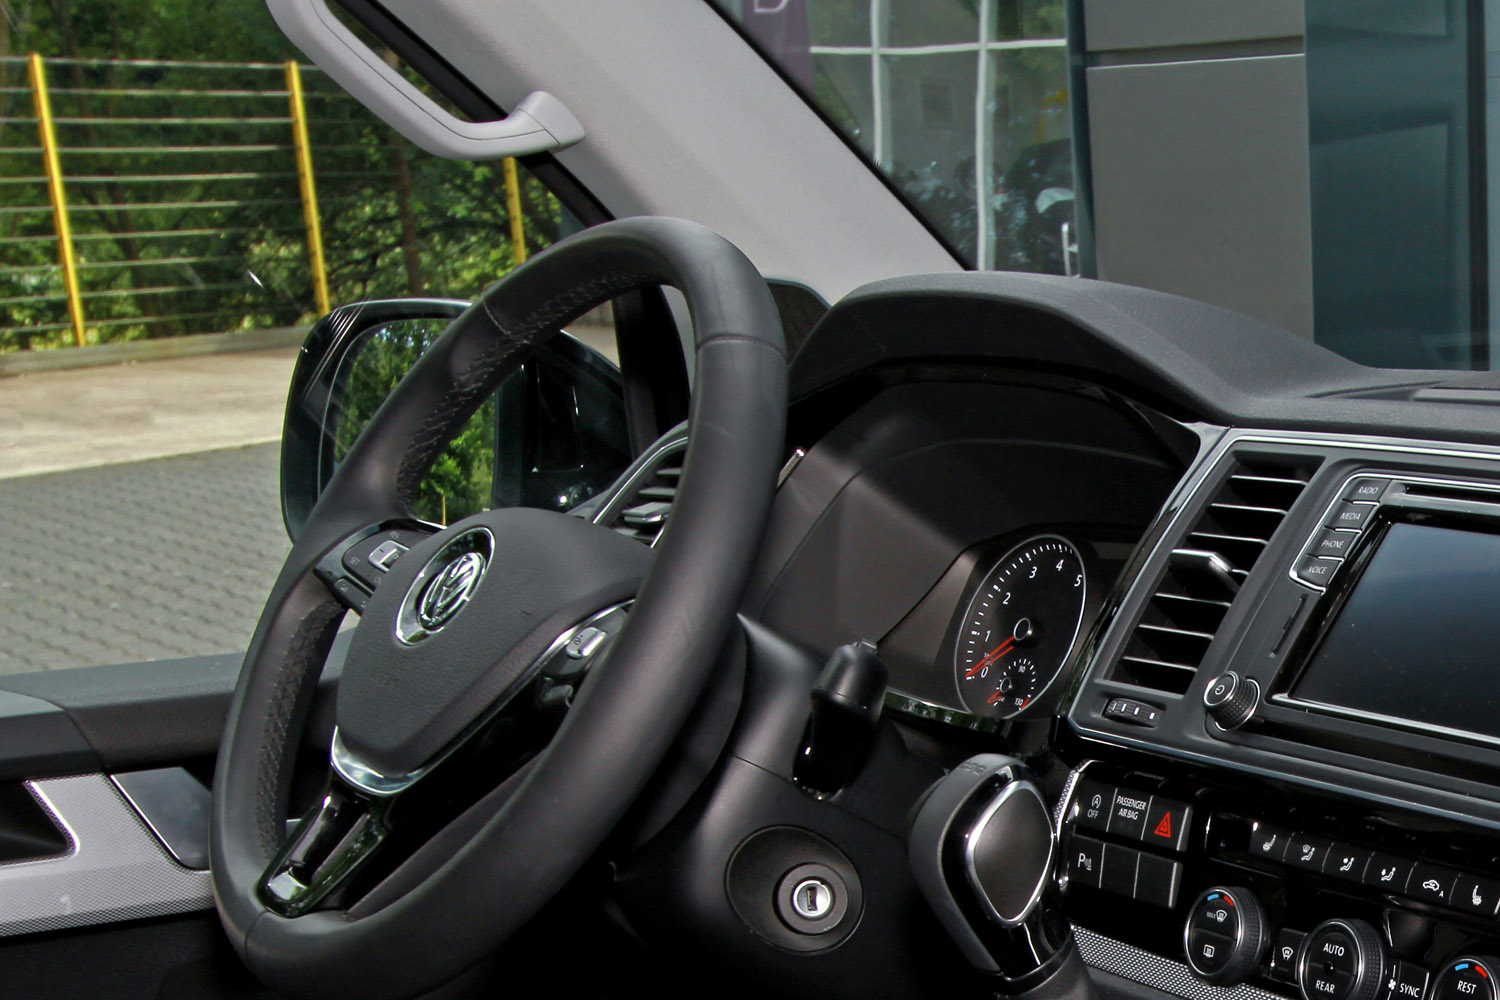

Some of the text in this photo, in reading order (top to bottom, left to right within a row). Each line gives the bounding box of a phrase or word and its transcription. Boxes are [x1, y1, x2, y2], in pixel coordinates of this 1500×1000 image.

[1357, 485, 1379, 495] RADIO
[1339, 511, 1362, 521] MEDIA
[1321, 539, 1345, 549] PHONE
[1055, 559, 1064, 572] 4
[1308, 565, 1328, 575] VOICE
[1029, 566, 1038, 579] 3
[1074, 574, 1083, 587] 5
[1002, 592, 1011, 605] 2
[985, 630, 991, 642] 1
[981, 666, 989, 678] 0
[1116, 795, 1147, 811] PASSENGER
[1087, 808, 1100, 819] OFF
[1323, 942, 1345, 957] AUTO
[1315, 979, 1336, 994] REAR
[1399, 982, 1421, 998] SYNC
[1456, 980, 1477, 995] REST
